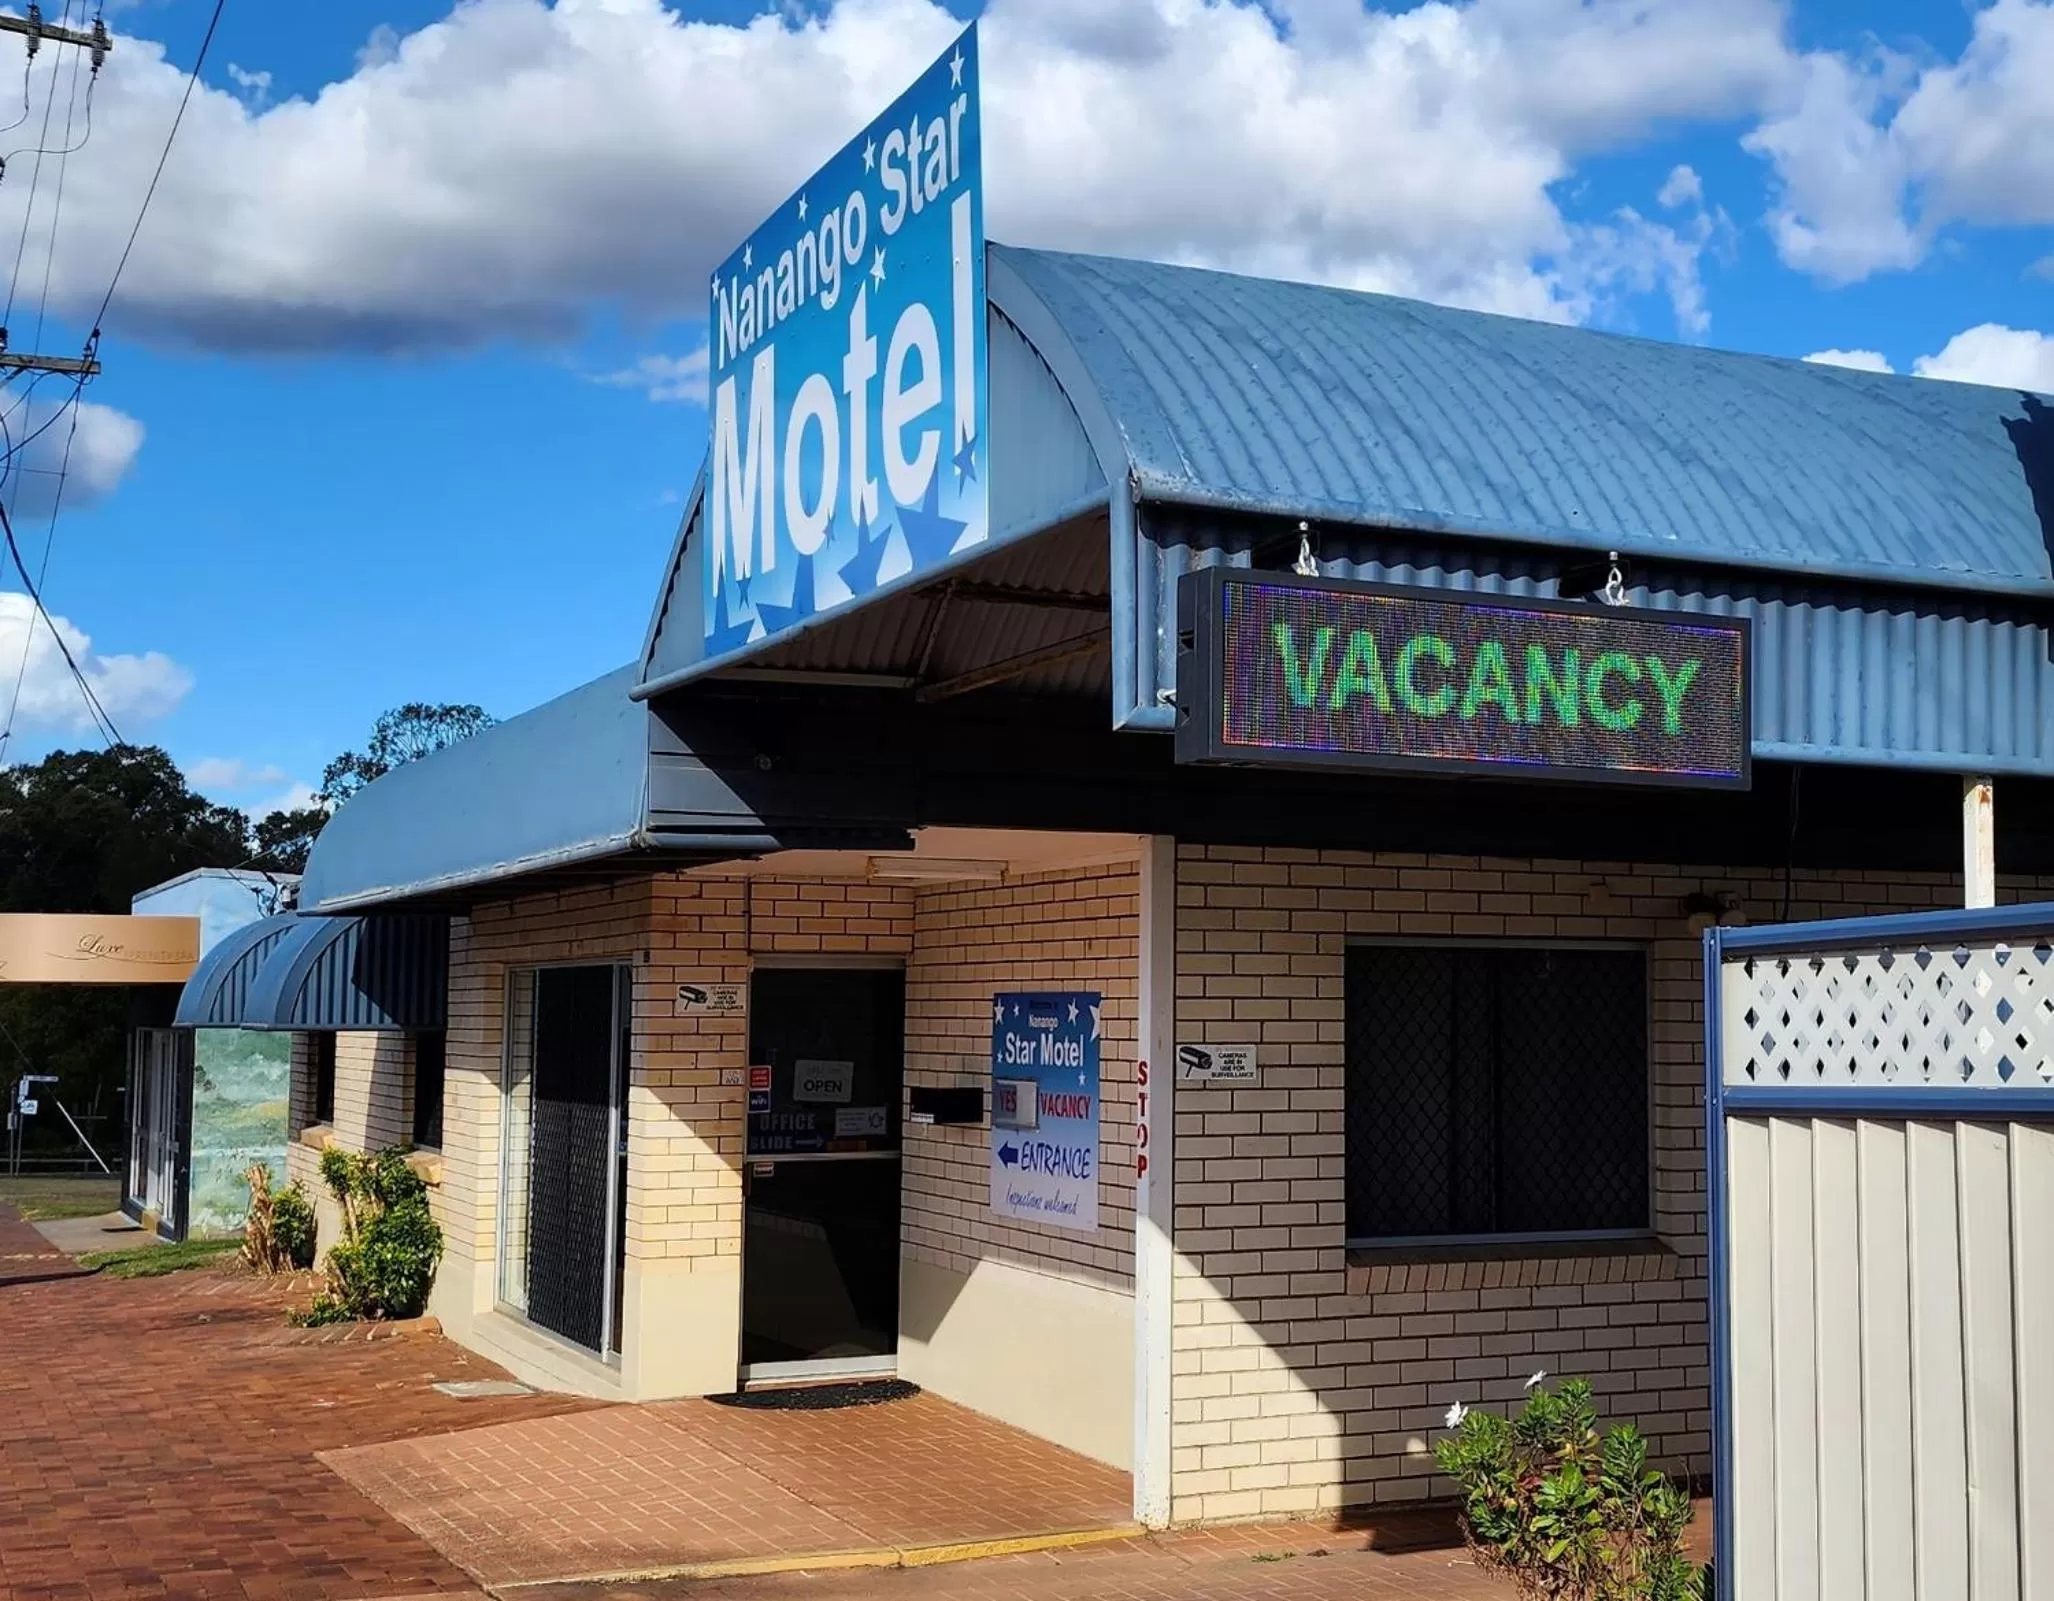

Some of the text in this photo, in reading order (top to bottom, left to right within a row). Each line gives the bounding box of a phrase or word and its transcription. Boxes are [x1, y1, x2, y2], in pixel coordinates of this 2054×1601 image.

[718, 91, 968, 370] Nanango Star
[712, 190, 977, 597] Motel
[1272, 621, 1703, 736] VACANCY
[76, 933, 125, 955] Luxe
[1028, 1014, 1059, 1031] Nanango
[1005, 1031, 1084, 1067] Star Motel
[803, 1078, 843, 1093] OPEN
[1000, 1089, 1017, 1113] YES
[760, 1112, 816, 1131] OFFICE
[1040, 1092, 1091, 1120] VACANCY
[1137, 1060, 1148, 1179] STOP
[1020, 1141, 1091, 1179] ENTRANCE
